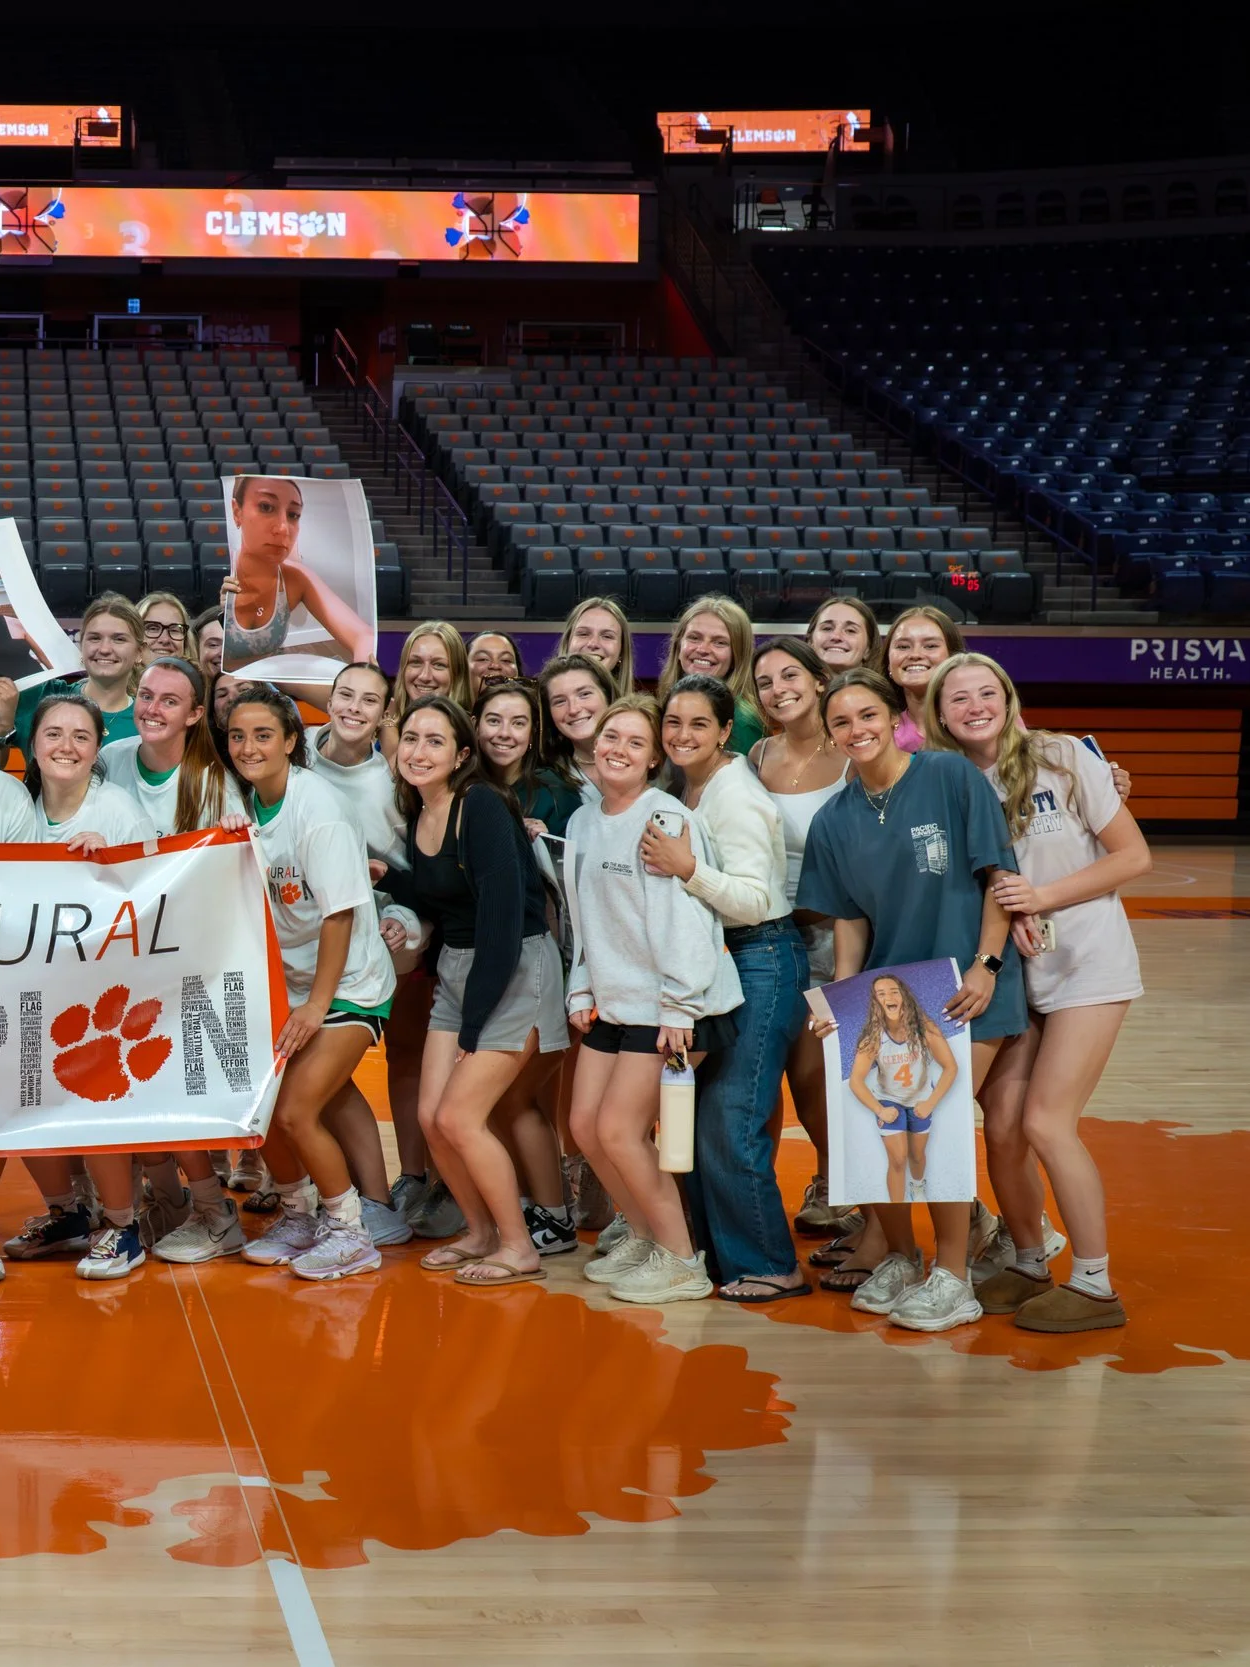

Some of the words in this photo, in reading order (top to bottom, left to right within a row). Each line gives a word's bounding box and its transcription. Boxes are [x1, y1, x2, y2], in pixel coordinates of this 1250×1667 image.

[1131, 639, 1246, 662] PRISMA
[224, 982, 244, 991] FLAG
[21, 1002, 41, 1011] FLAG
[182, 1004, 214, 1012] SPIKEBALL
[193, 1013, 202, 1056] VOLLEYBALL
[185, 1063, 204, 1072] FLAG
[221, 1059, 248, 1068] EFFORT
[893, 1063, 914, 1088] 4
